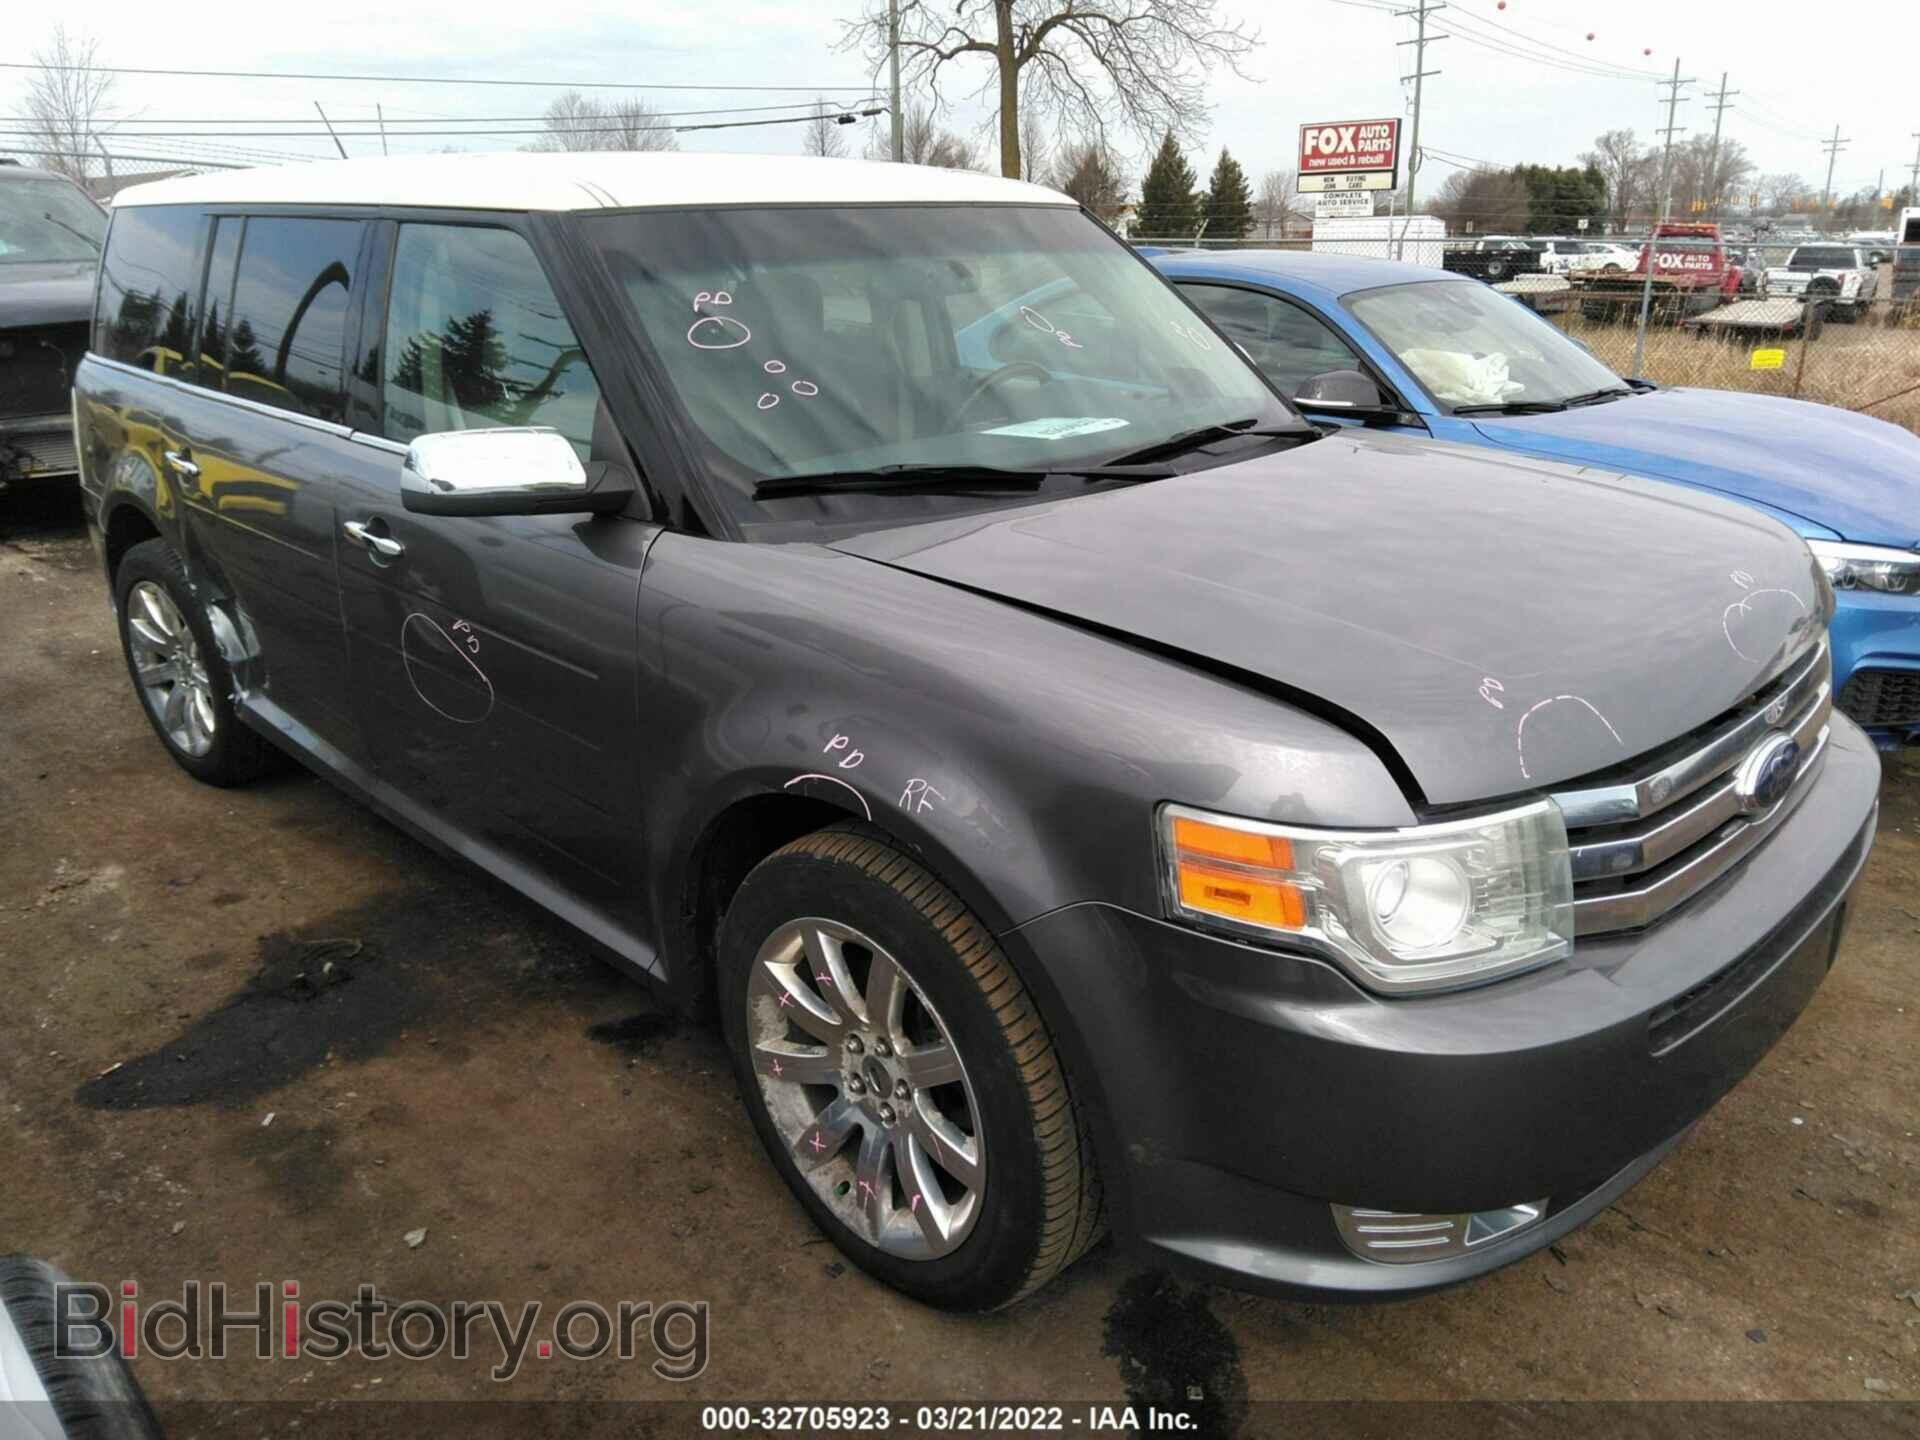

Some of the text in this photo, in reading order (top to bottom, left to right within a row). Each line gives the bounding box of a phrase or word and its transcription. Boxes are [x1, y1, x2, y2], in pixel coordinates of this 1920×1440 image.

[1359, 124, 1389, 138] AUTO
[1304, 127, 1357, 155] FOX
[1358, 138, 1391, 152] PARTS
[1309, 158, 1327, 167] new
